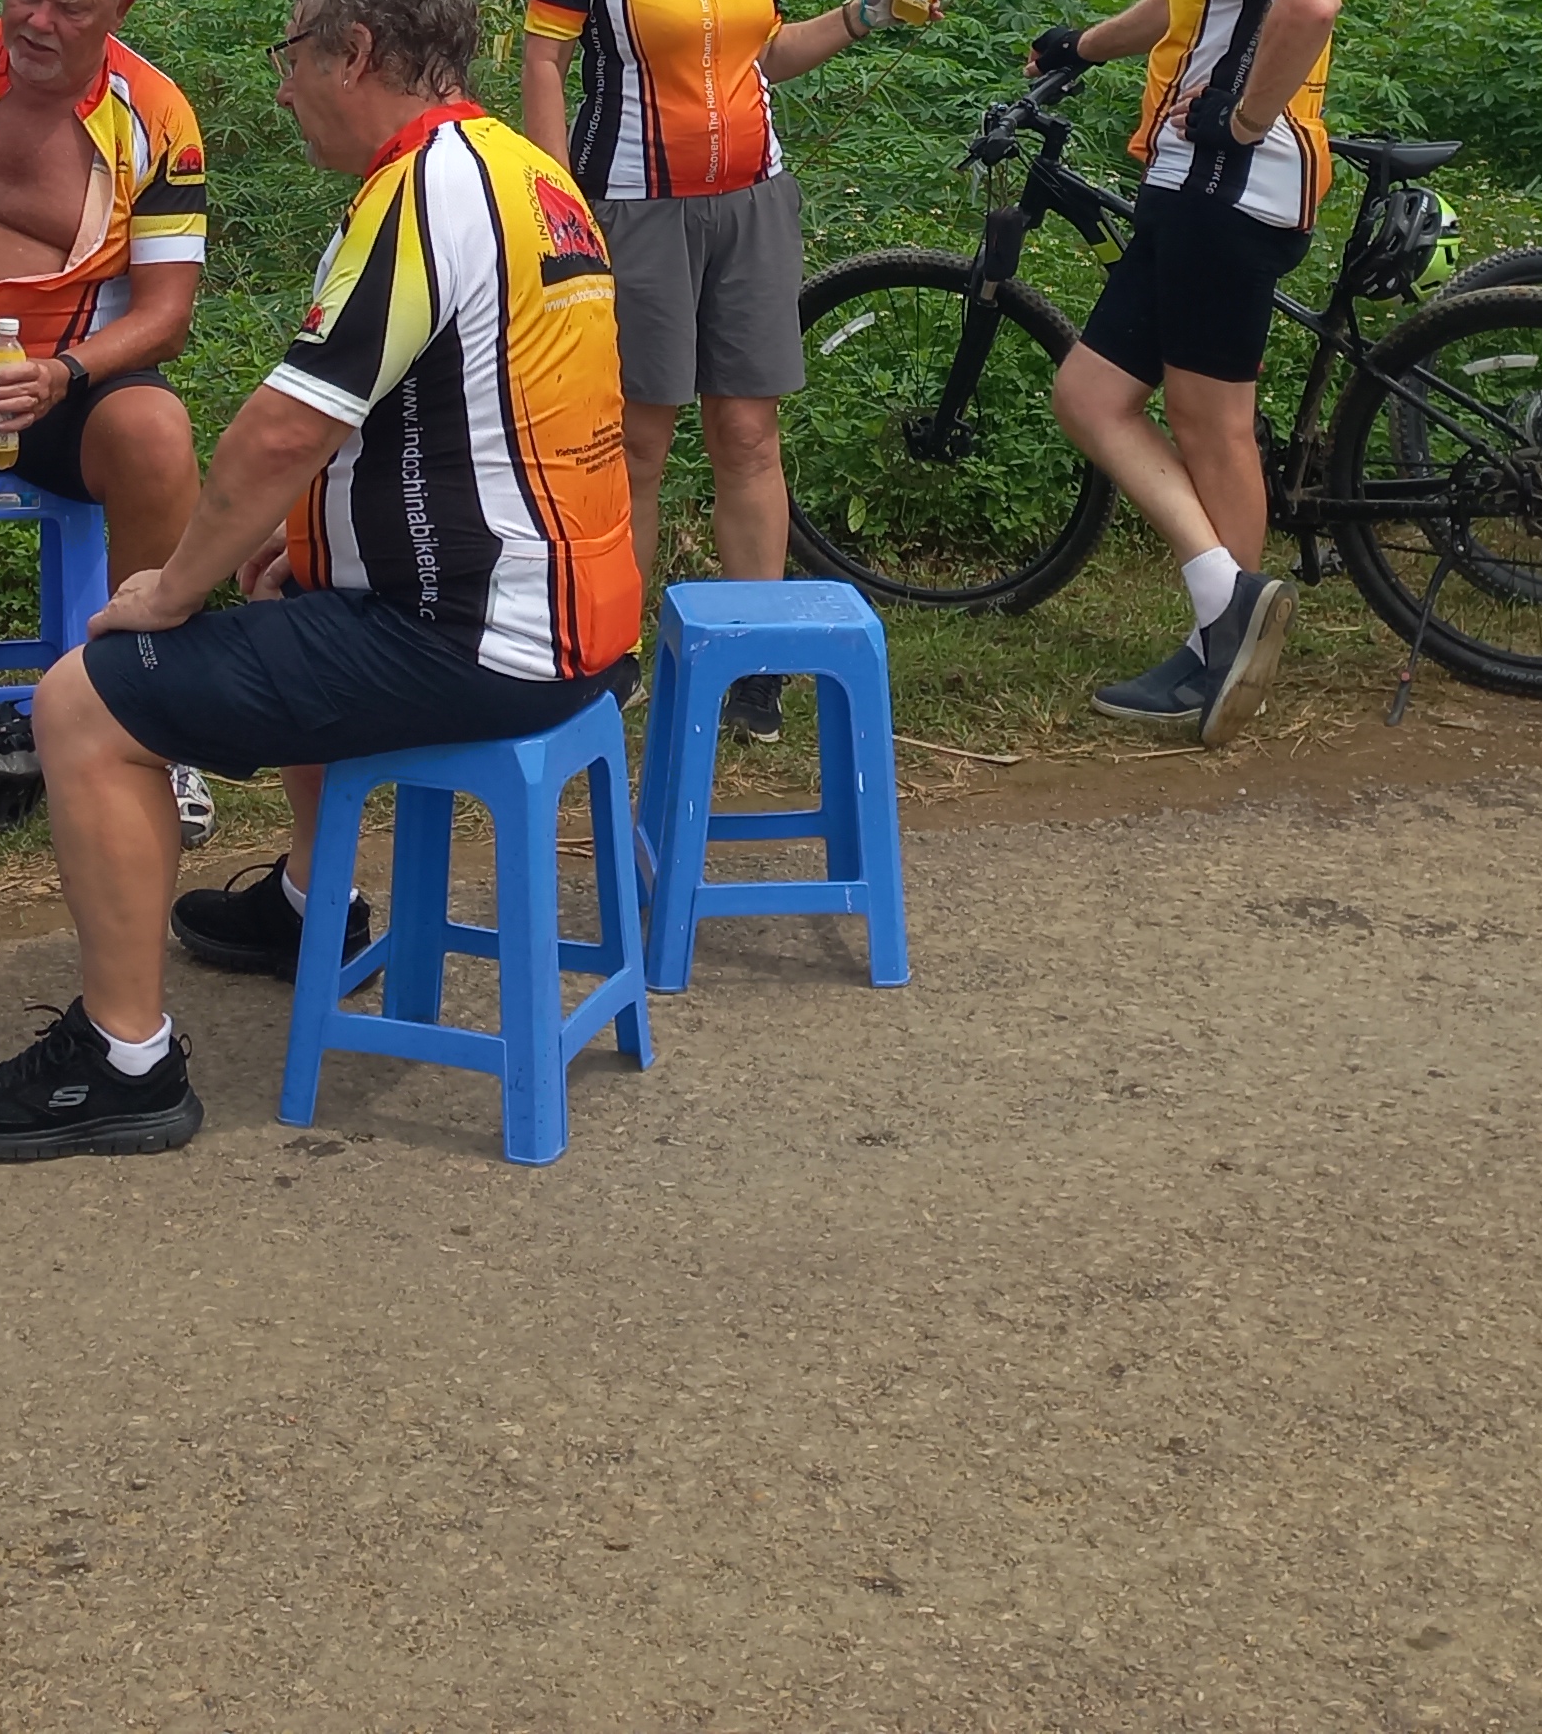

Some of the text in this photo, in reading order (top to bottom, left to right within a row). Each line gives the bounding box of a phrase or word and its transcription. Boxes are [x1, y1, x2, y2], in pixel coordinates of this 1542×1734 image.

[702, 32, 713, 68] Charm
[704, 69, 716, 109] Hidden
[708, 111, 719, 132] The
[705, 133, 719, 183] Discovers
